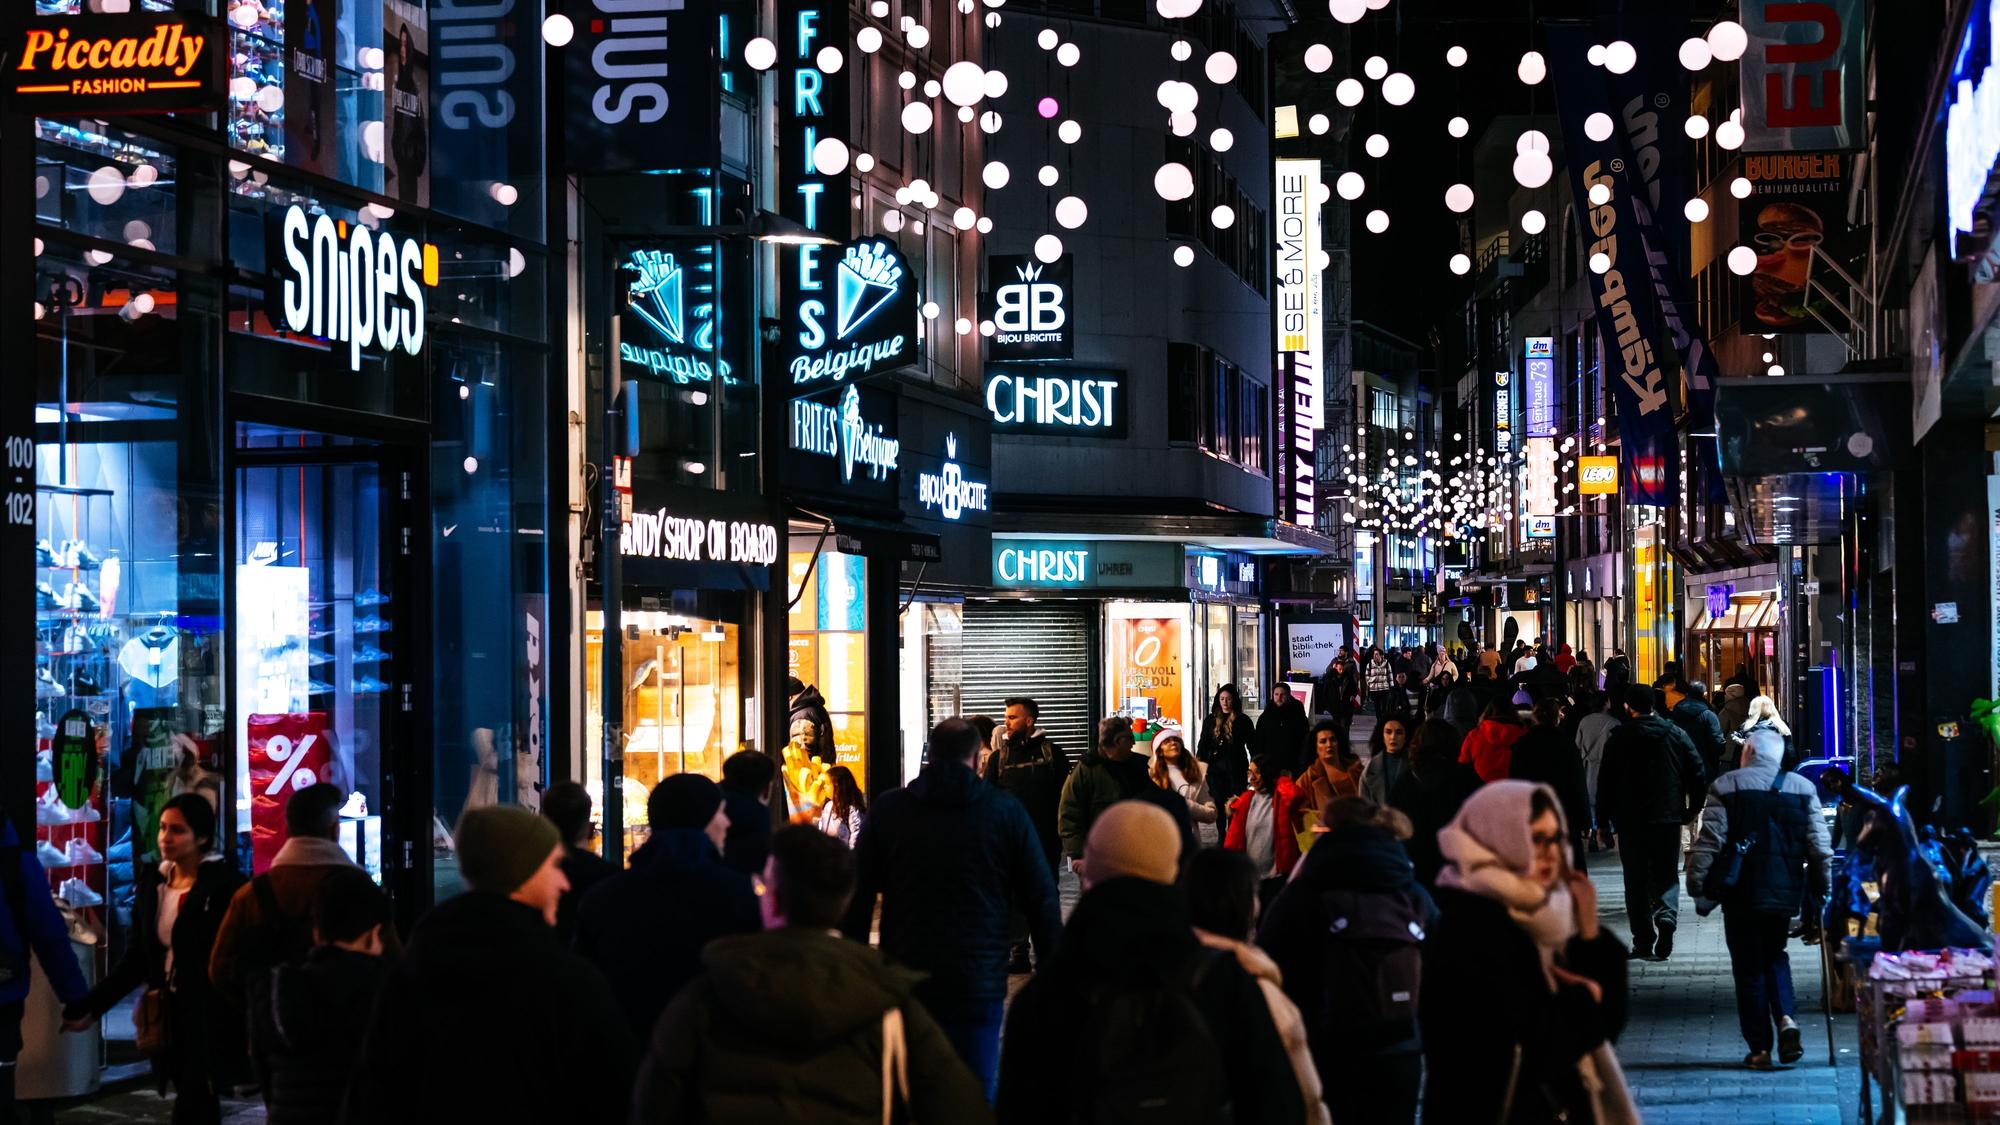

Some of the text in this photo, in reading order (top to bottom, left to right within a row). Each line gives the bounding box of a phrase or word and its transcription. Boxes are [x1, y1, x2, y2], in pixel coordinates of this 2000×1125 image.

[18, 24, 204, 76] Piccadly
[72, 78, 146, 95] FASHION
[797, 10, 824, 350] FRITES
[1745, 154, 1840, 181] BURGER
[1751, 182, 1841, 194] REMIUMQUALITÄT
[1283, 175, 1302, 261] MORE
[284, 205, 425, 371] snipes
[998, 333, 1062, 344] BIJOU BRIGITTE
[1533, 341, 1548, 350] dm
[790, 335, 904, 384] Belgique
[1531, 361, 1548, 380] 73
[987, 374, 1119, 426] CHRIST
[795, 400, 838, 457] FRITES
[5, 435, 33, 470] 100
[854, 419, 899, 481] Belgique
[6, 492, 33, 525] 102
[919, 473, 942, 510] BIJOU
[620, 507, 778, 568] ANDY SHOP ON BOARD
[1535, 520, 1550, 528] dm
[997, 548, 1089, 583] CHRIST
[1292, 635, 1313, 643] stadt
[1293, 641, 1334, 650] bibliothek
[1293, 651, 1311, 659] köln
